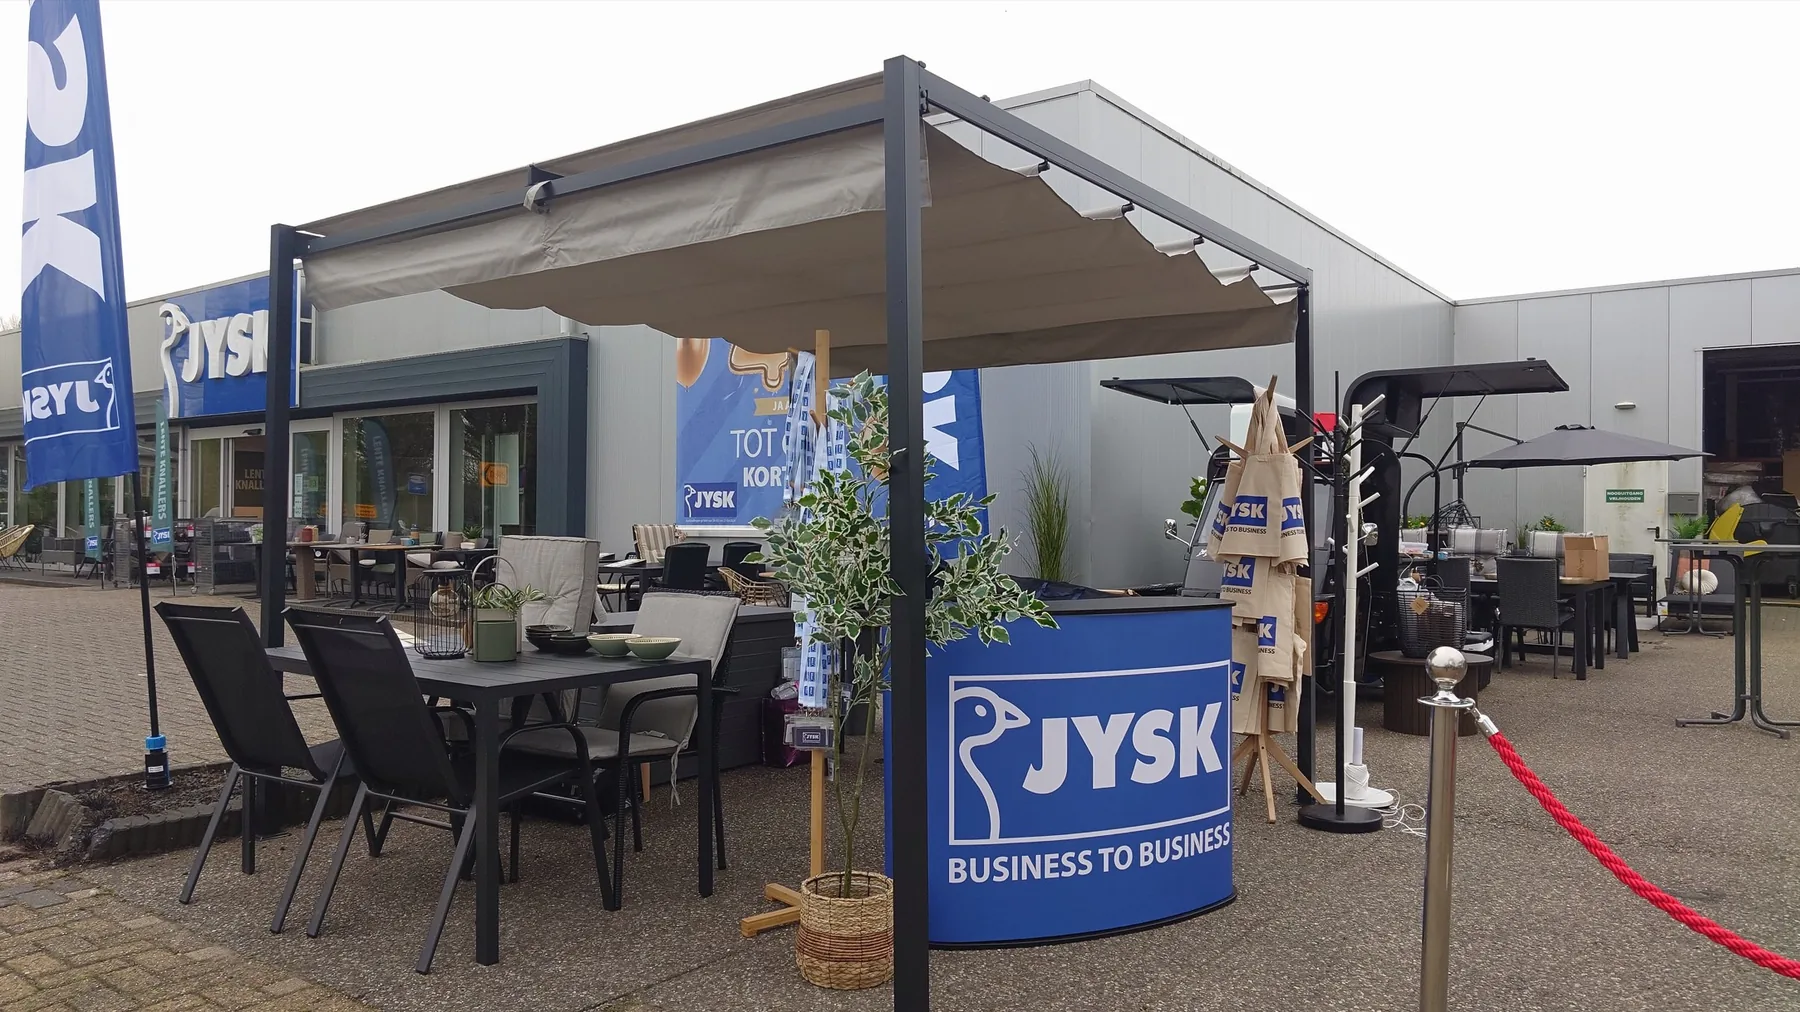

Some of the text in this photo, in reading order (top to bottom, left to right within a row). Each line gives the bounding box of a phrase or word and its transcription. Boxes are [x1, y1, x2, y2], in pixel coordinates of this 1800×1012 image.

[730, 427, 778, 459] TOT
[158, 459, 168, 520] KNALLERS
[694, 490, 736, 509] JYSK
[1238, 527, 1267, 535] BUSINESS
[1226, 587, 1252, 595] BUSINESS
[1022, 701, 1223, 795] JYSK
[948, 821, 1231, 884] BUSINESS TO BUSINESS
